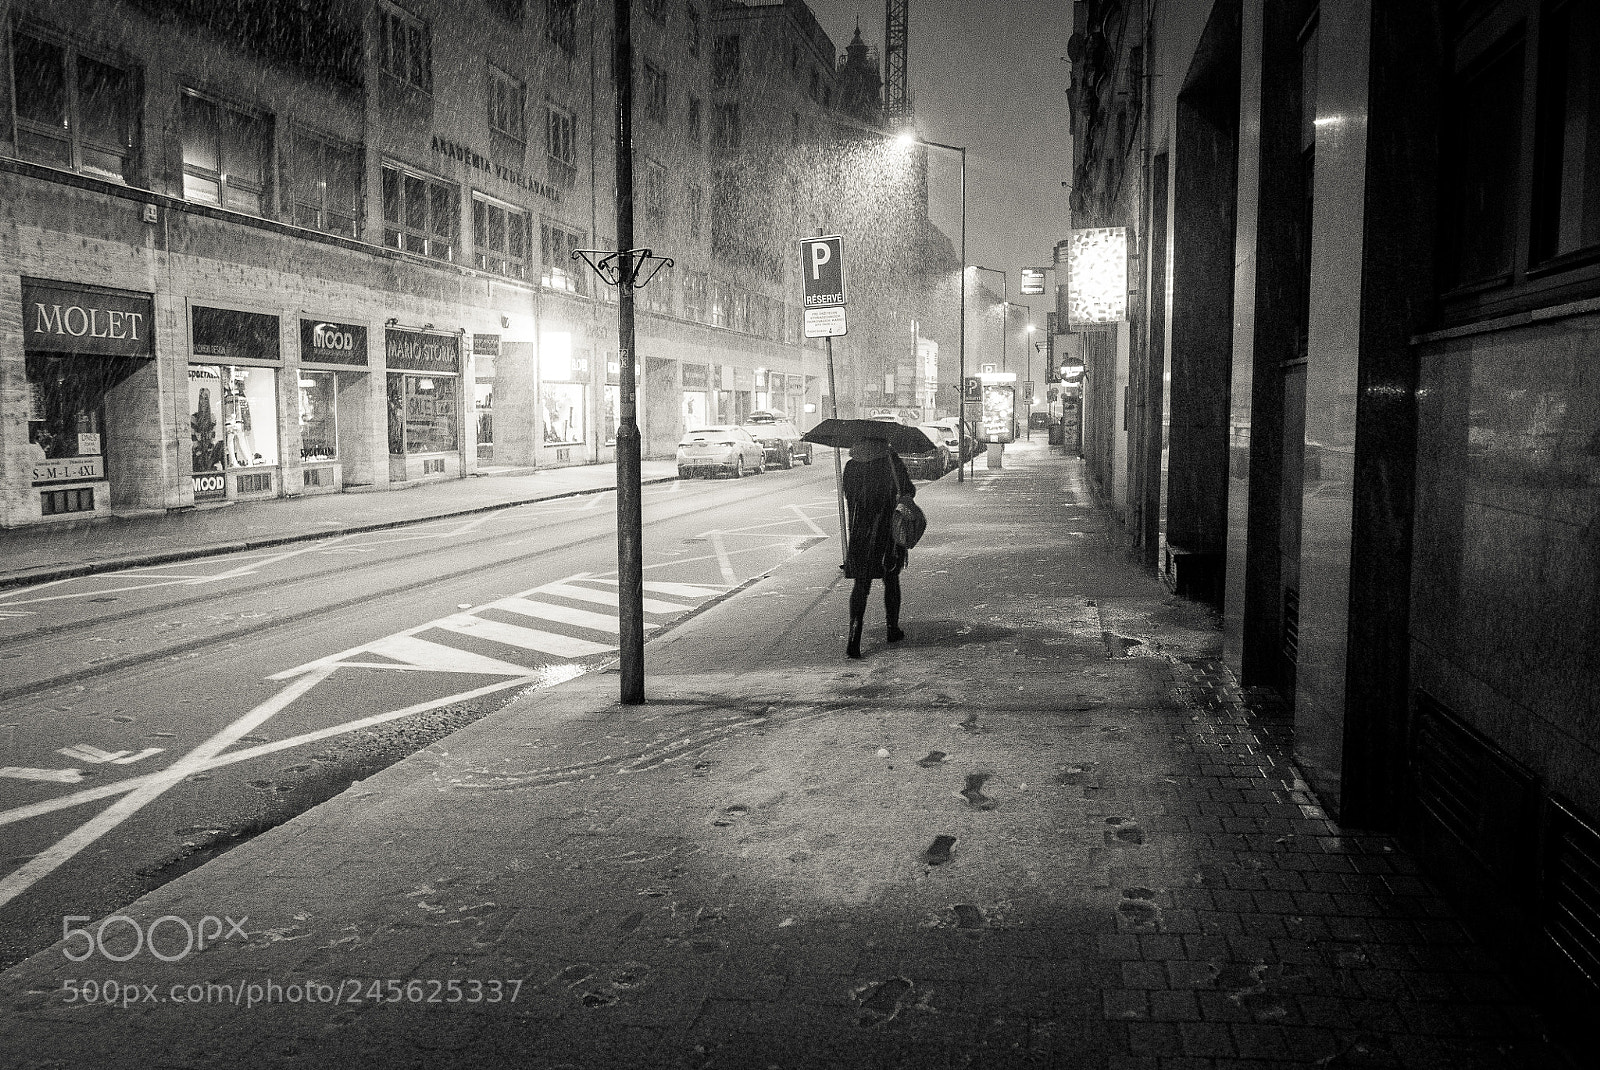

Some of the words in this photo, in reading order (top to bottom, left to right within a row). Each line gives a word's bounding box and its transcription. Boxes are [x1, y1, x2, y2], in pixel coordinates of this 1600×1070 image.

[811, 242, 831, 280] P
[806, 292, 842, 305] RÉSERVÉ
[34, 302, 143, 341] MOLET
[313, 324, 353, 351] MOOD
[387, 339, 421, 360] MARIO
[192, 476, 225, 492] MOOD
